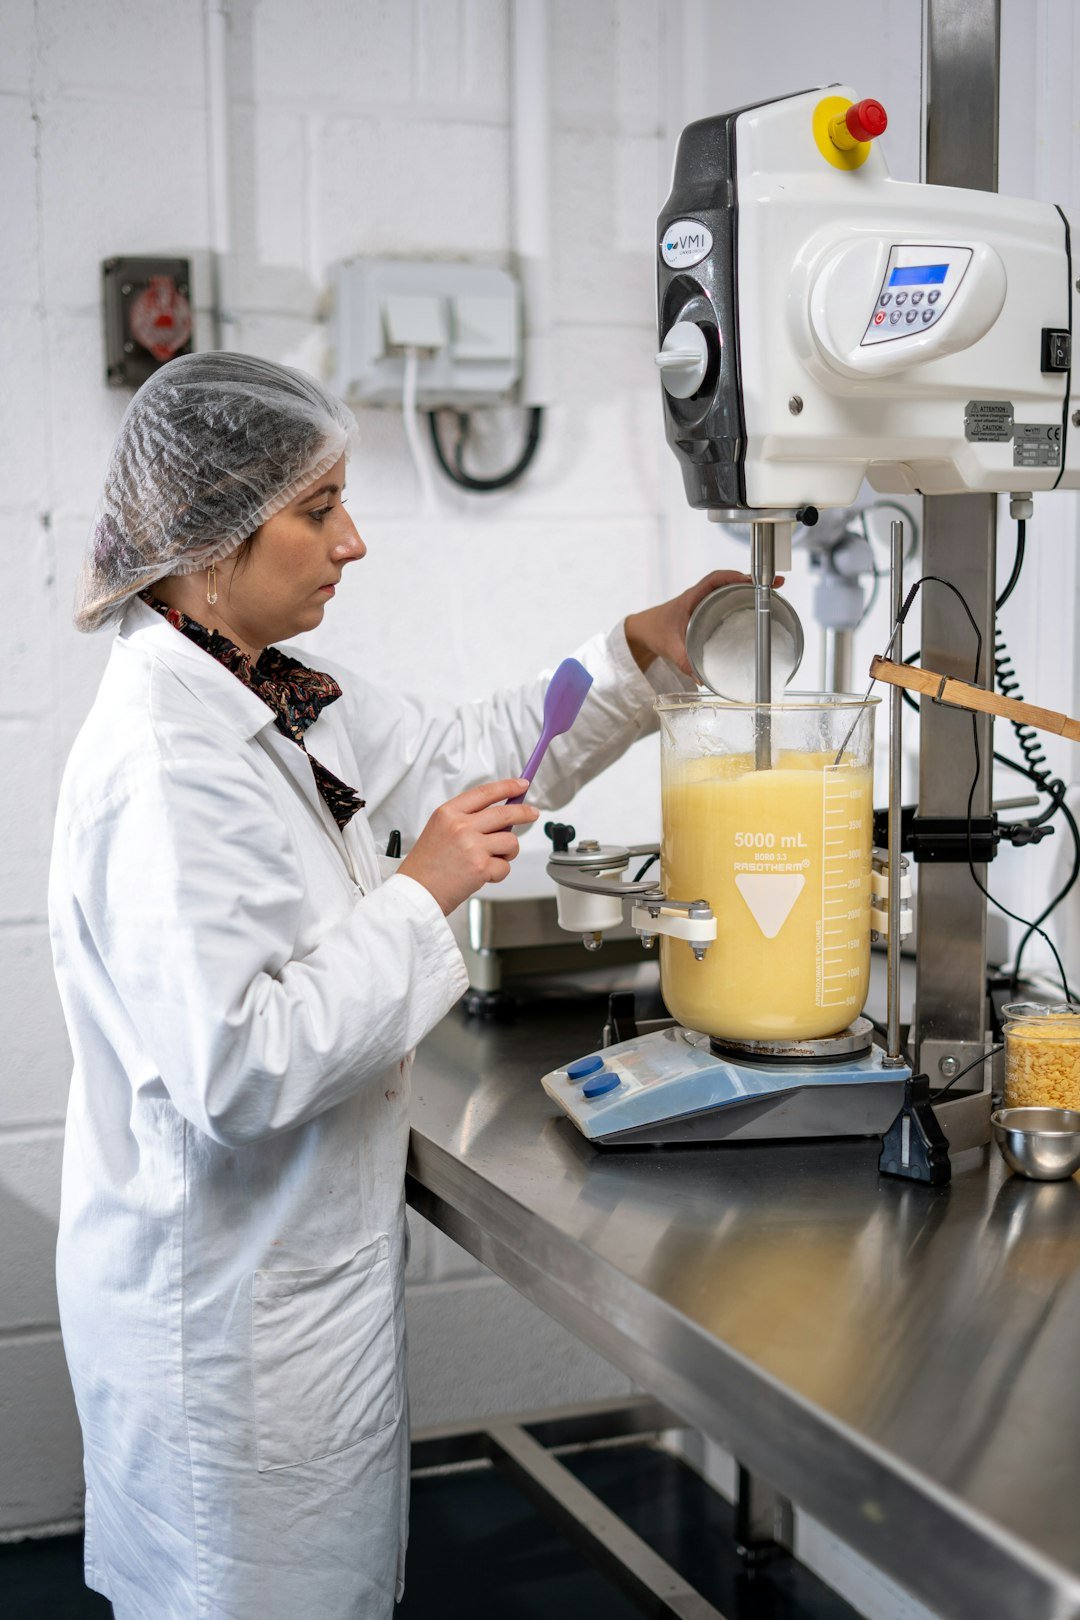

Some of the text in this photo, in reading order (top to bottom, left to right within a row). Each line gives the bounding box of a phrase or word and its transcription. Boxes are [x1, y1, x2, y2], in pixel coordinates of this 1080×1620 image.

[679, 234, 704, 249] VMI
[849, 820, 862, 830] 3500
[734, 832, 808, 848] 5000 mL
[754, 852, 788, 860] BORO 3.3
[848, 878, 860, 888] 2500
[848, 908, 860, 920] 2000
[848, 939, 860, 949] 1500
[848, 967, 860, 978] 1000
[846, 996, 856, 1006] 500
